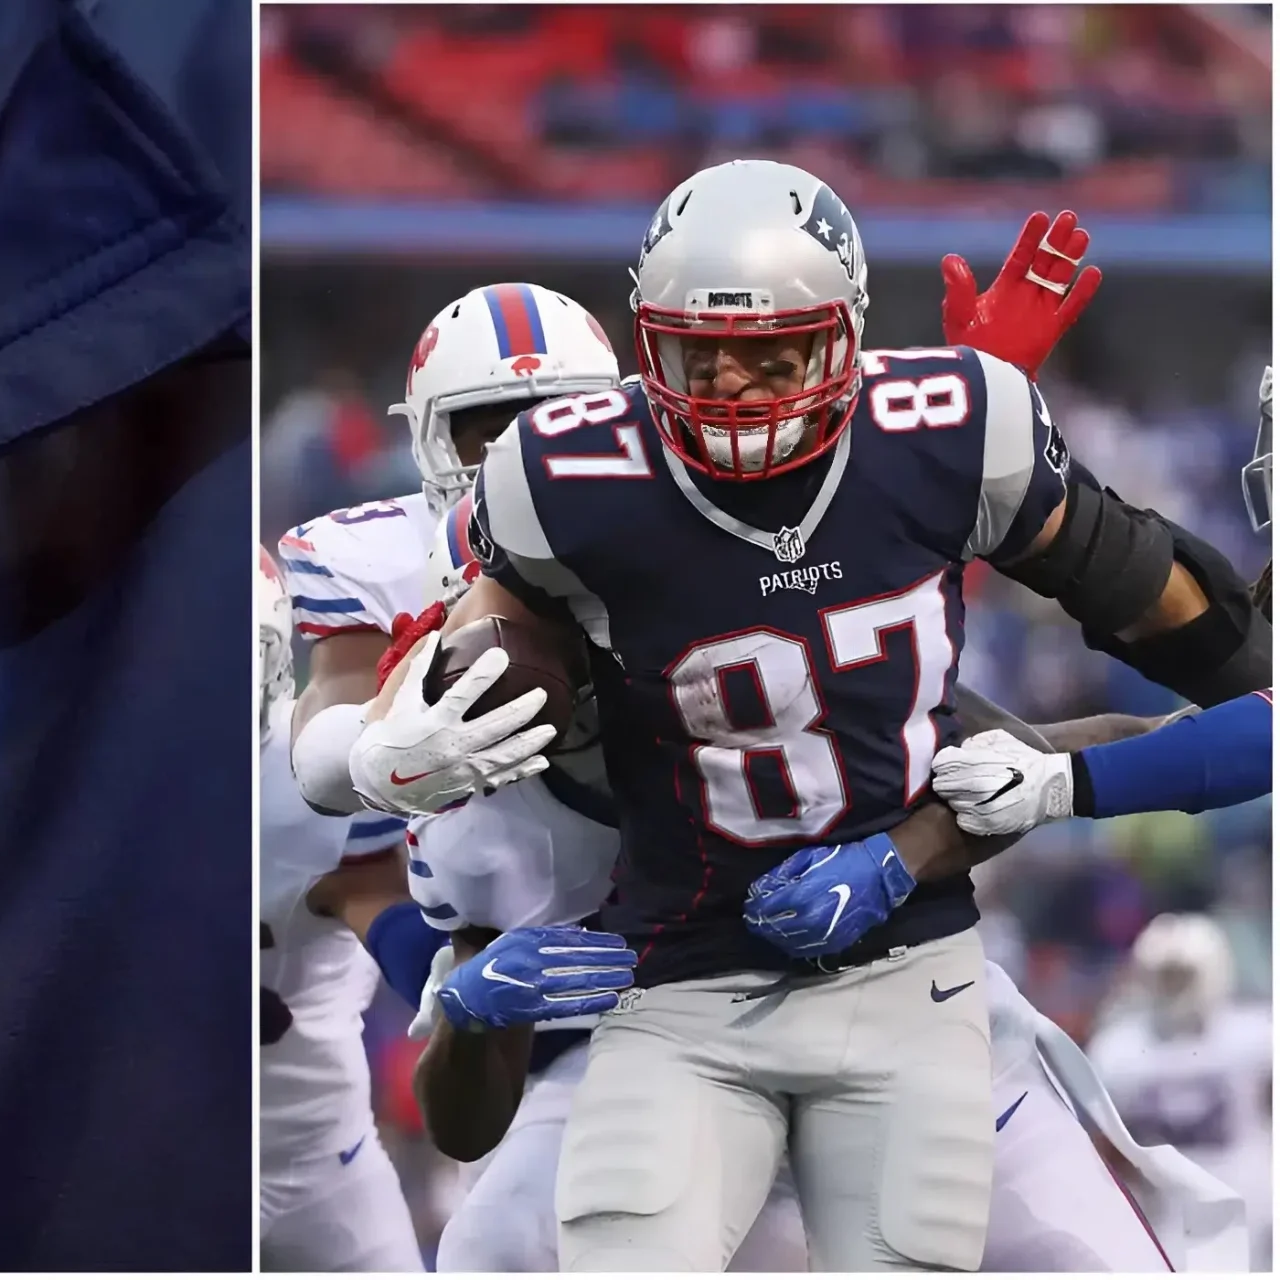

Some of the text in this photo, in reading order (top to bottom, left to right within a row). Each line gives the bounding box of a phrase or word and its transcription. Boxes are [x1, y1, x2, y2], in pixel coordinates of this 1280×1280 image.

[529, 389, 655, 480] 87
[759, 561, 843, 597] PATRIOTS
[666, 569, 954, 846] 87
